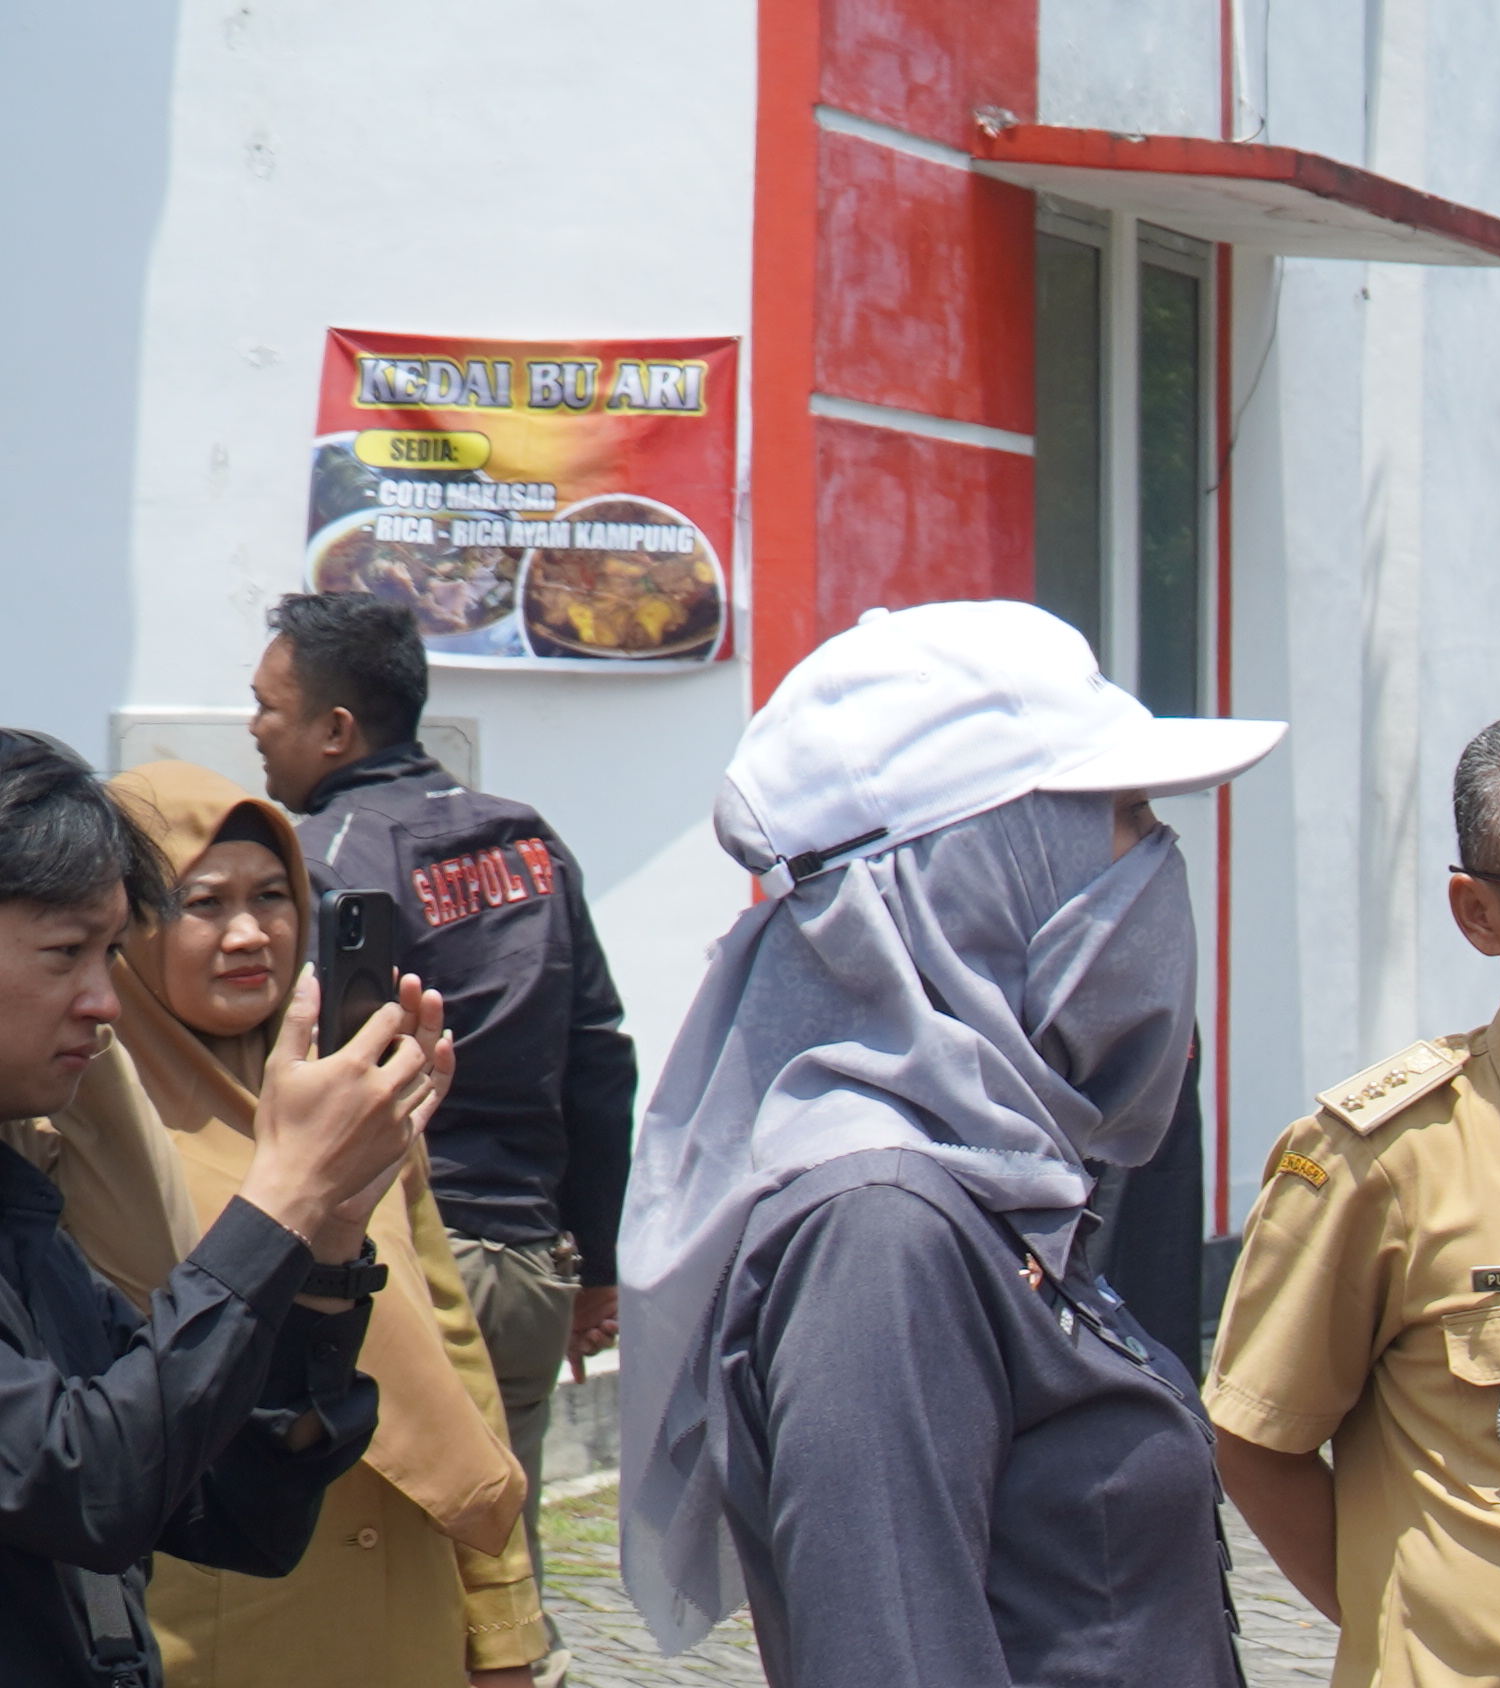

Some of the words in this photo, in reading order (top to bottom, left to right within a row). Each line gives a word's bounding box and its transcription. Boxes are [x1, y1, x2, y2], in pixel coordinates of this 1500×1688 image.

[358, 357, 513, 407] KEDAI
[527, 360, 598, 412] BU
[606, 361, 704, 412] ARI
[390, 438, 459, 463] SEDIA:
[378, 478, 444, 511] COTO
[445, 481, 558, 512] MAKASAR
[374, 514, 435, 545] RICA
[452, 518, 507, 548] RICA
[508, 520, 571, 549] AYAM
[574, 522, 696, 554] KAMPUNG
[411, 846, 529, 928] SATPOL
